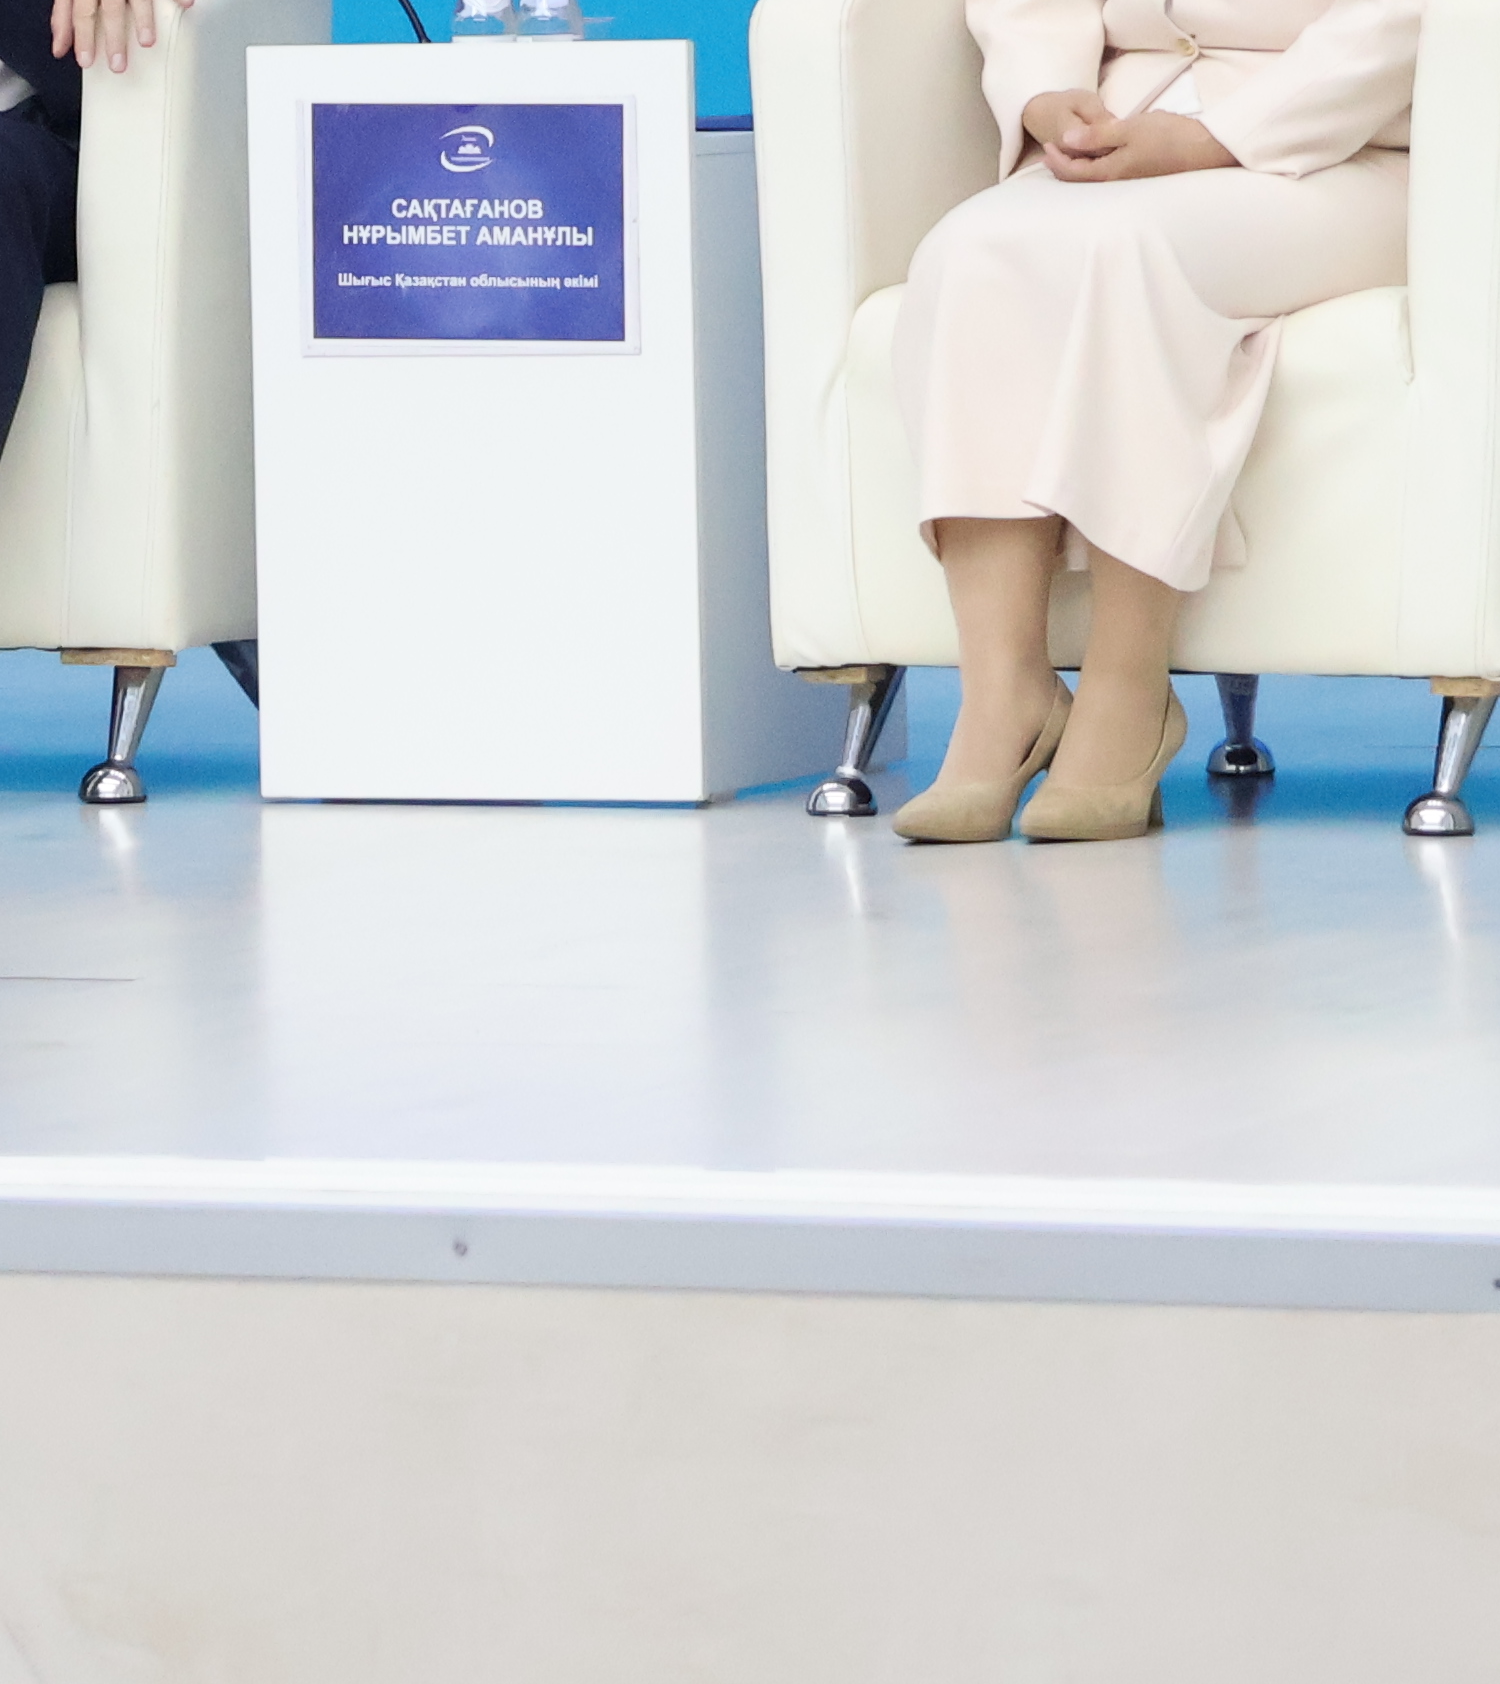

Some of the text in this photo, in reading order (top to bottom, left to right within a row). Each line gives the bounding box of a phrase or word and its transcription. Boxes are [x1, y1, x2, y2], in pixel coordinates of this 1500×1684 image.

[391, 198, 544, 222] САҚТАҒАНОВ
[343, 224, 594, 247] НҰРЫМБЕТ АМАНҰЛЫ
[395, 272, 467, 289] Қазақстан
